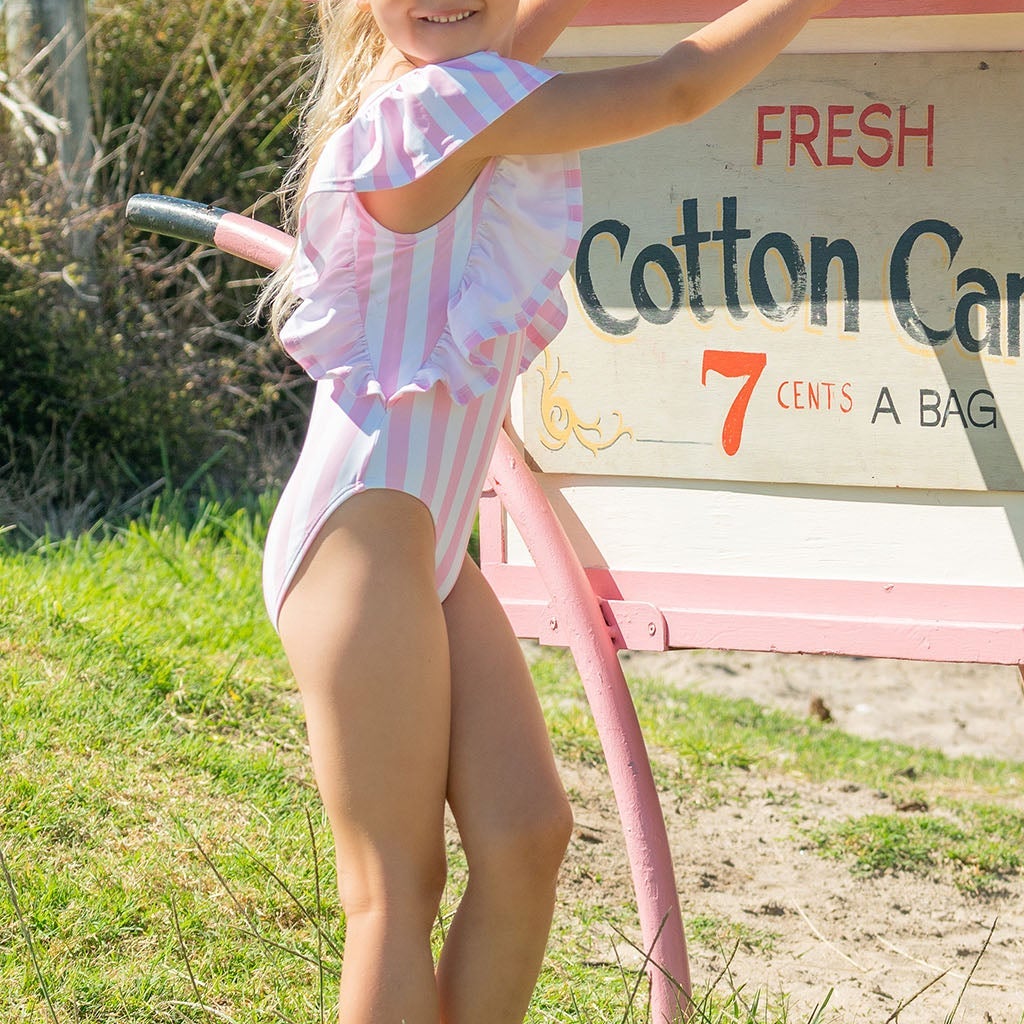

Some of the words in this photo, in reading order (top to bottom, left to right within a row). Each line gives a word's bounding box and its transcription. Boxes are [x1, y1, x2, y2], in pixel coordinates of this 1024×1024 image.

[757, 104, 936, 167] FRESH
[574, 196, 860, 337] Cotton
[701, 350, 768, 456] 7
[777, 380, 854, 415] CENTS
[871, 386, 901, 427] A
[919, 388, 999, 430] BAG
